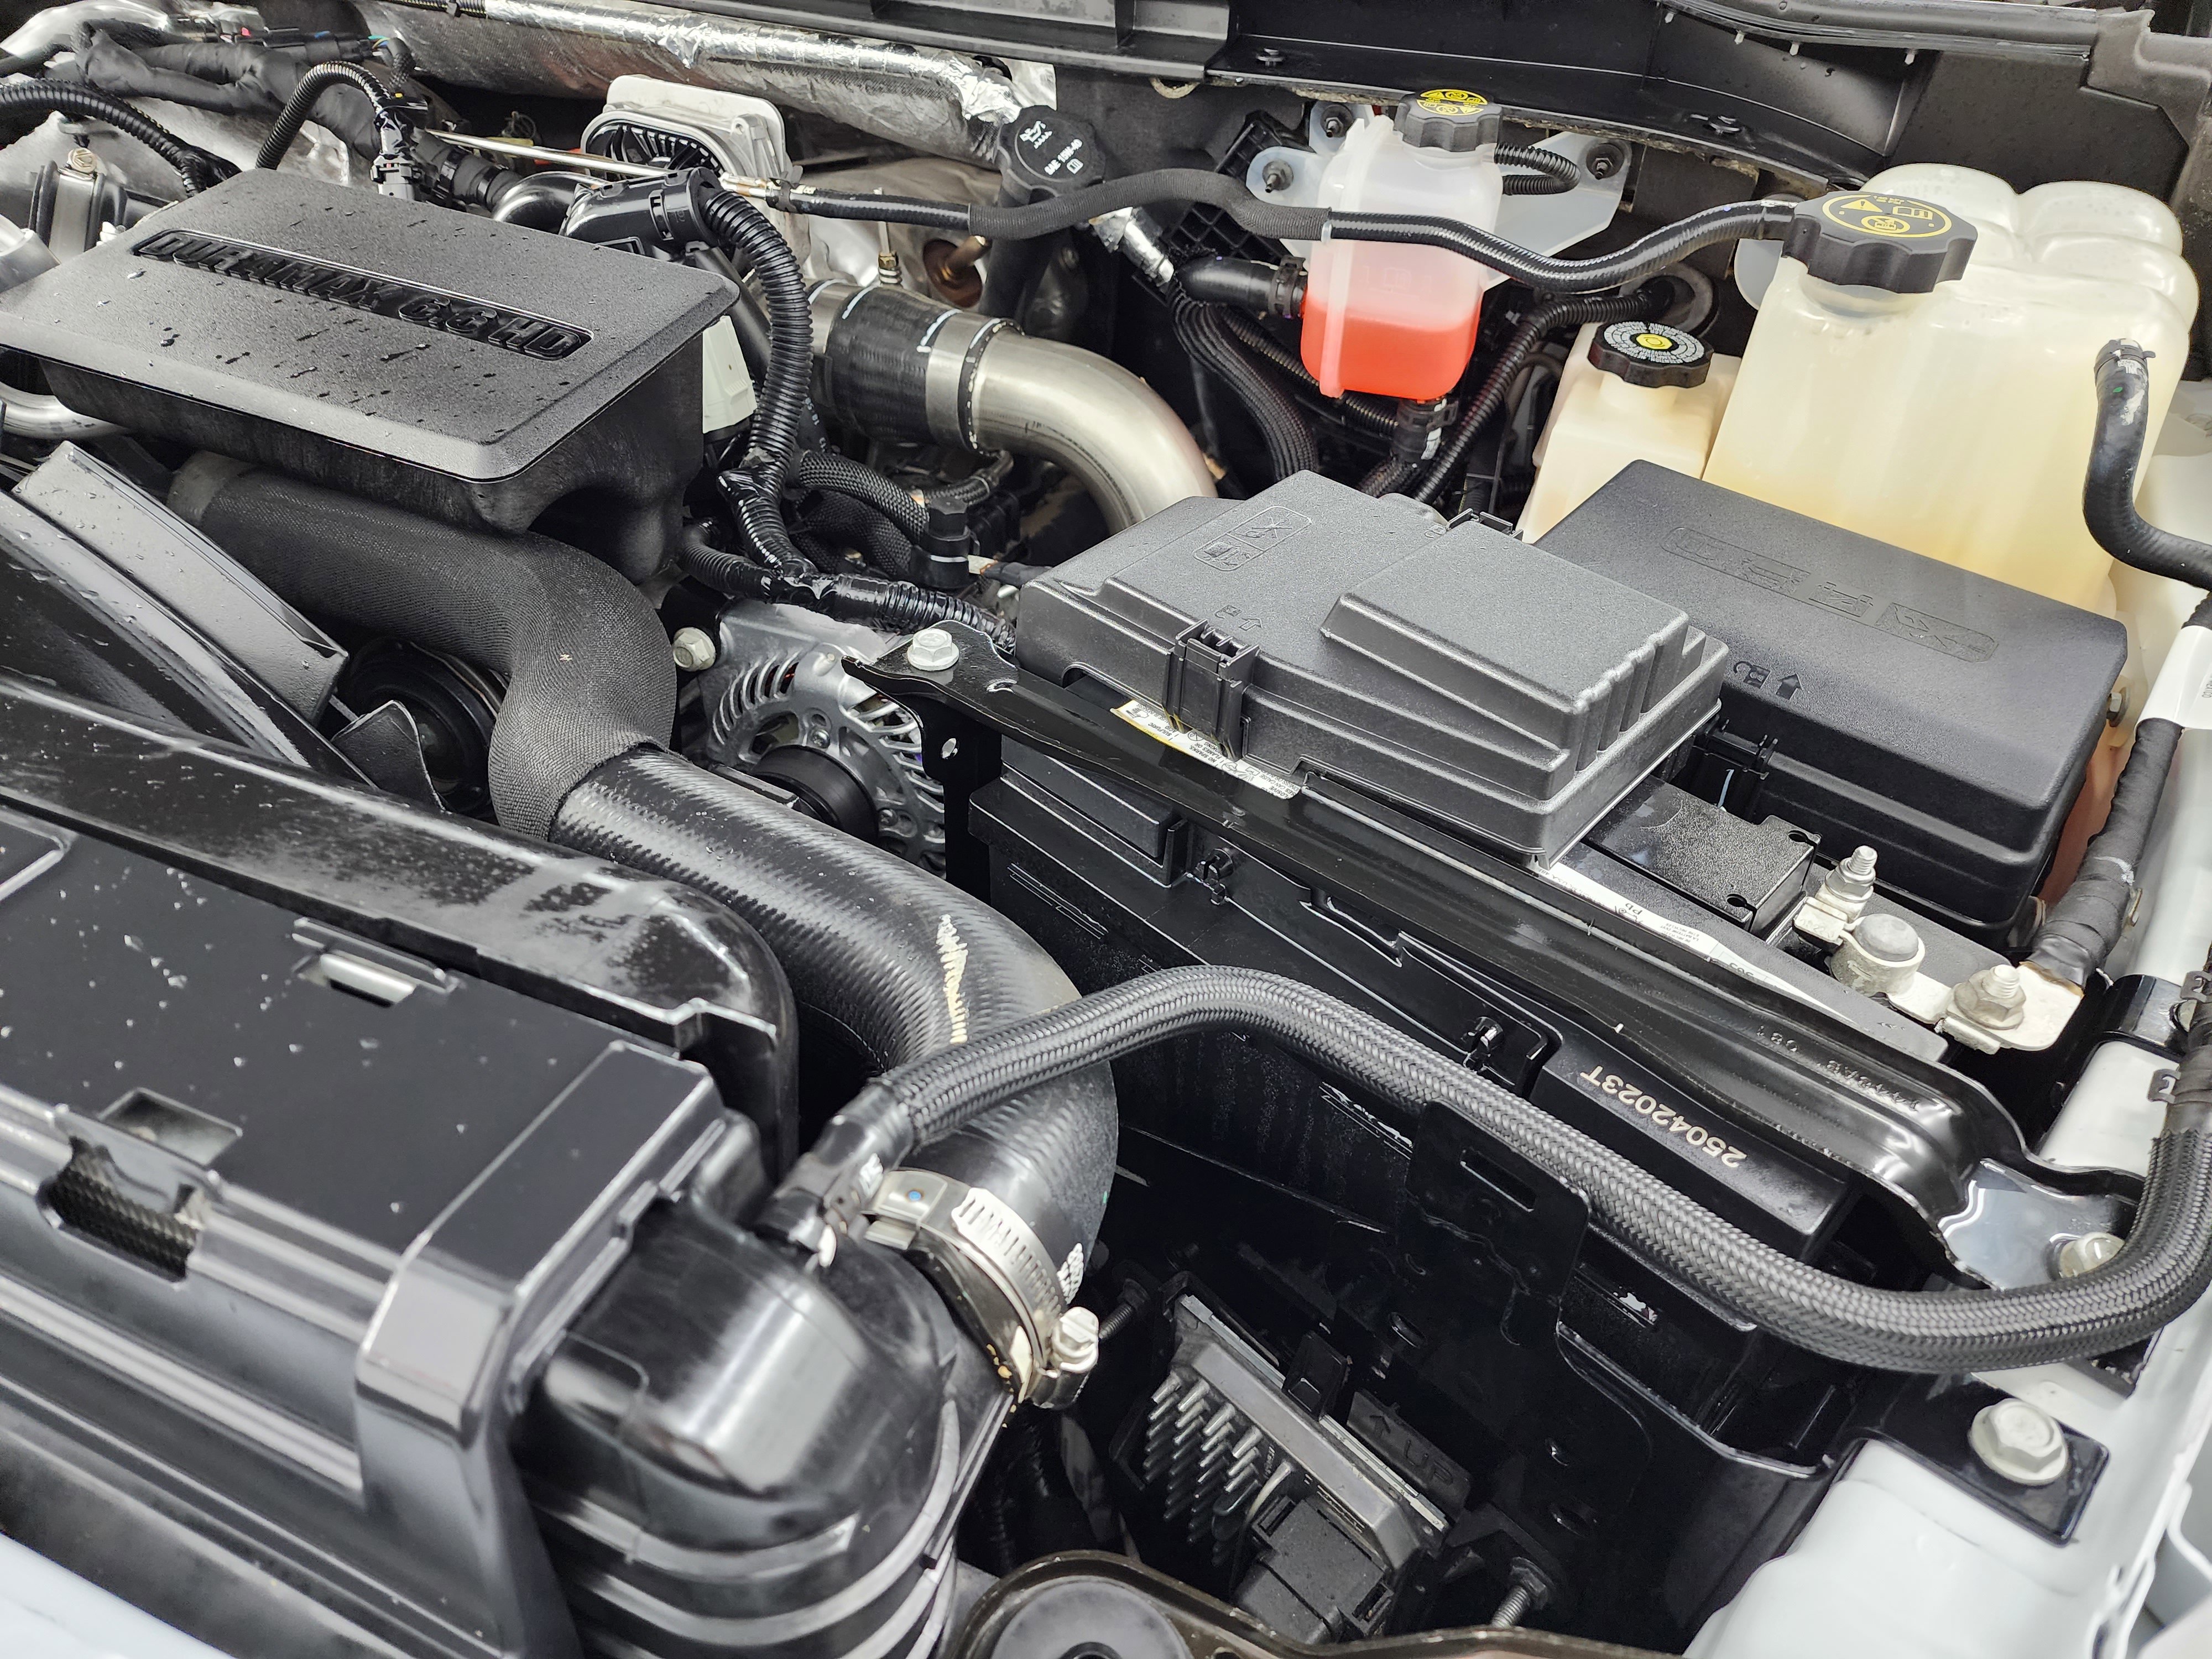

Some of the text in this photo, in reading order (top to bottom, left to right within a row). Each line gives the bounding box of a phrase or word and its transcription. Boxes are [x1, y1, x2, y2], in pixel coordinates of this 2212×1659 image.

[1044, 159, 1061, 175] SAE
[140, 232, 582, 357] DURAMAX 6.6 HD
[1147, 722, 1172, 737] SULFURIC
[1202, 747, 1222, 760] FLAMES
[1259, 774, 1276, 784] CAUSE
[1624, 902, 1642, 915] Pb
[1580, 1065, 1748, 1168] 25042023T
[1403, 1439, 1454, 1484] UP
